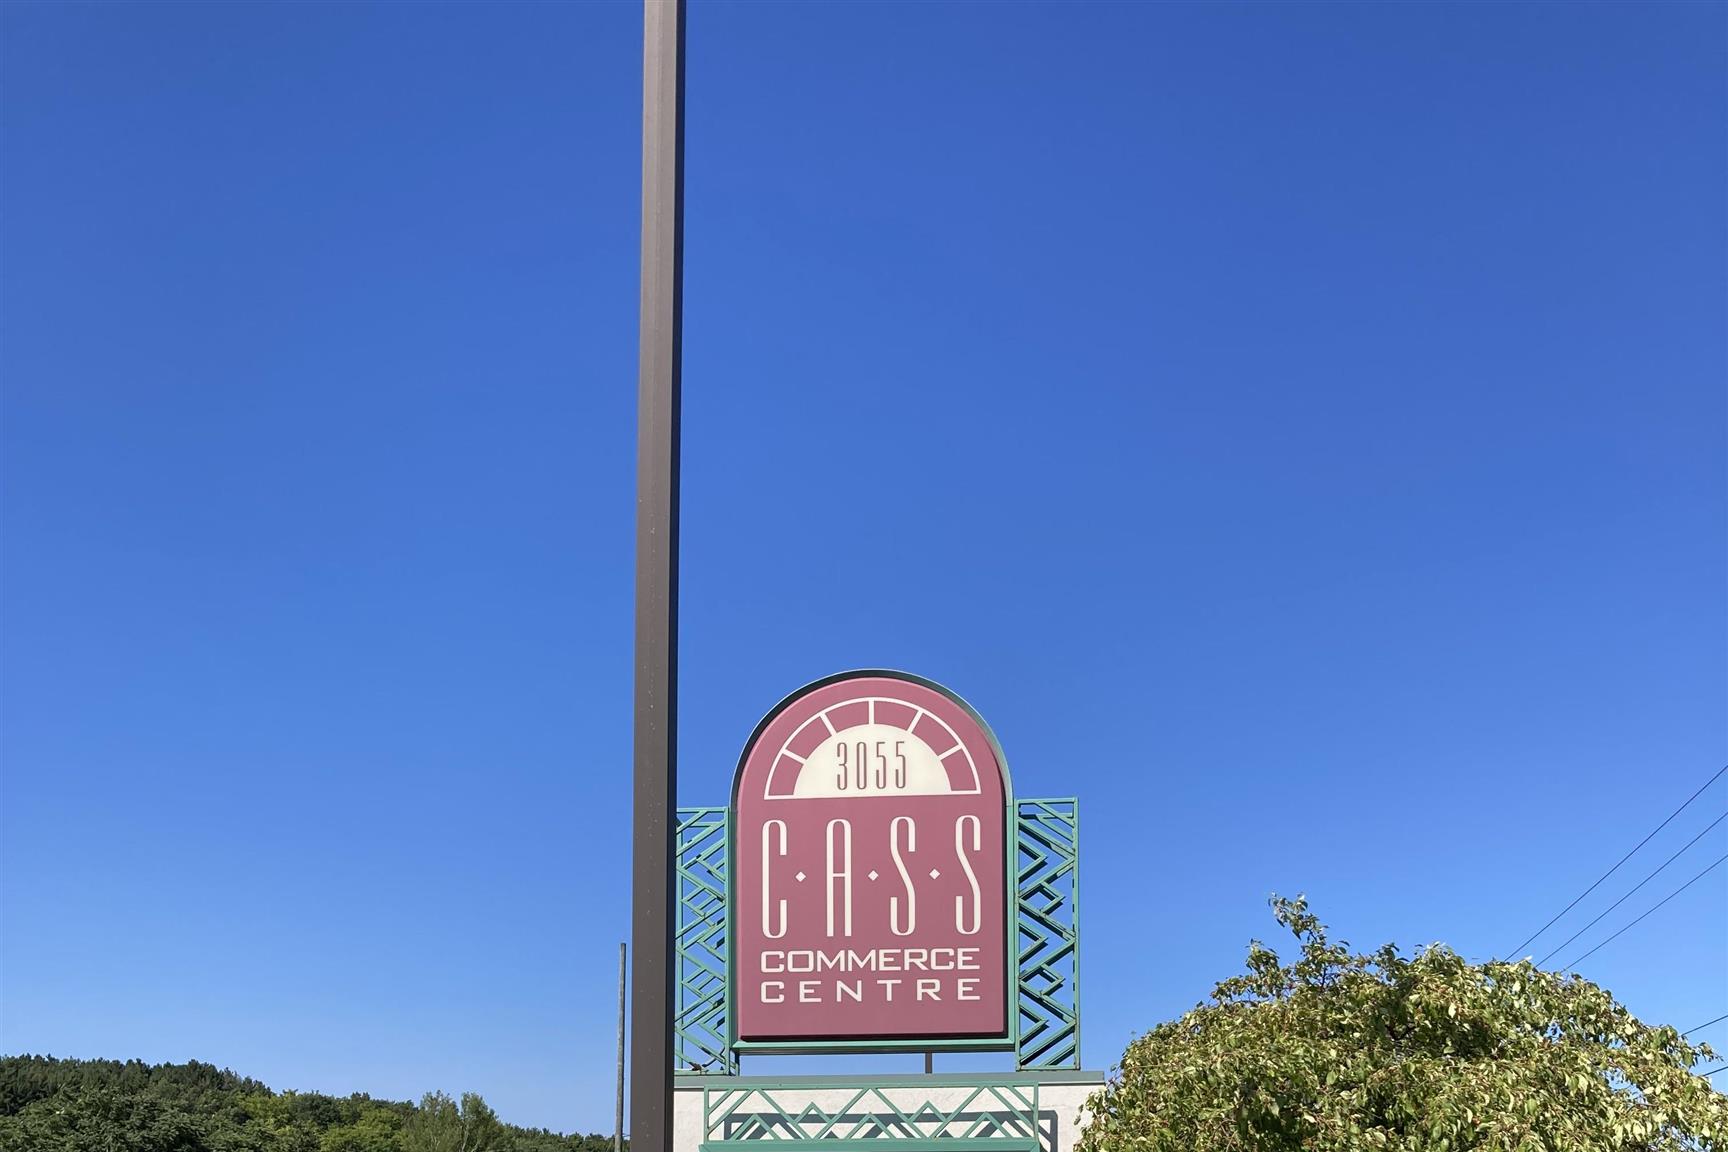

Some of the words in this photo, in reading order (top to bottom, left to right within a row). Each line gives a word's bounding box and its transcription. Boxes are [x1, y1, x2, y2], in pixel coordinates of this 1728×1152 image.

[837, 741, 907, 790] 3055
[760, 947, 980, 973] COMMERCE
[760, 978, 981, 1004] CENTRE
